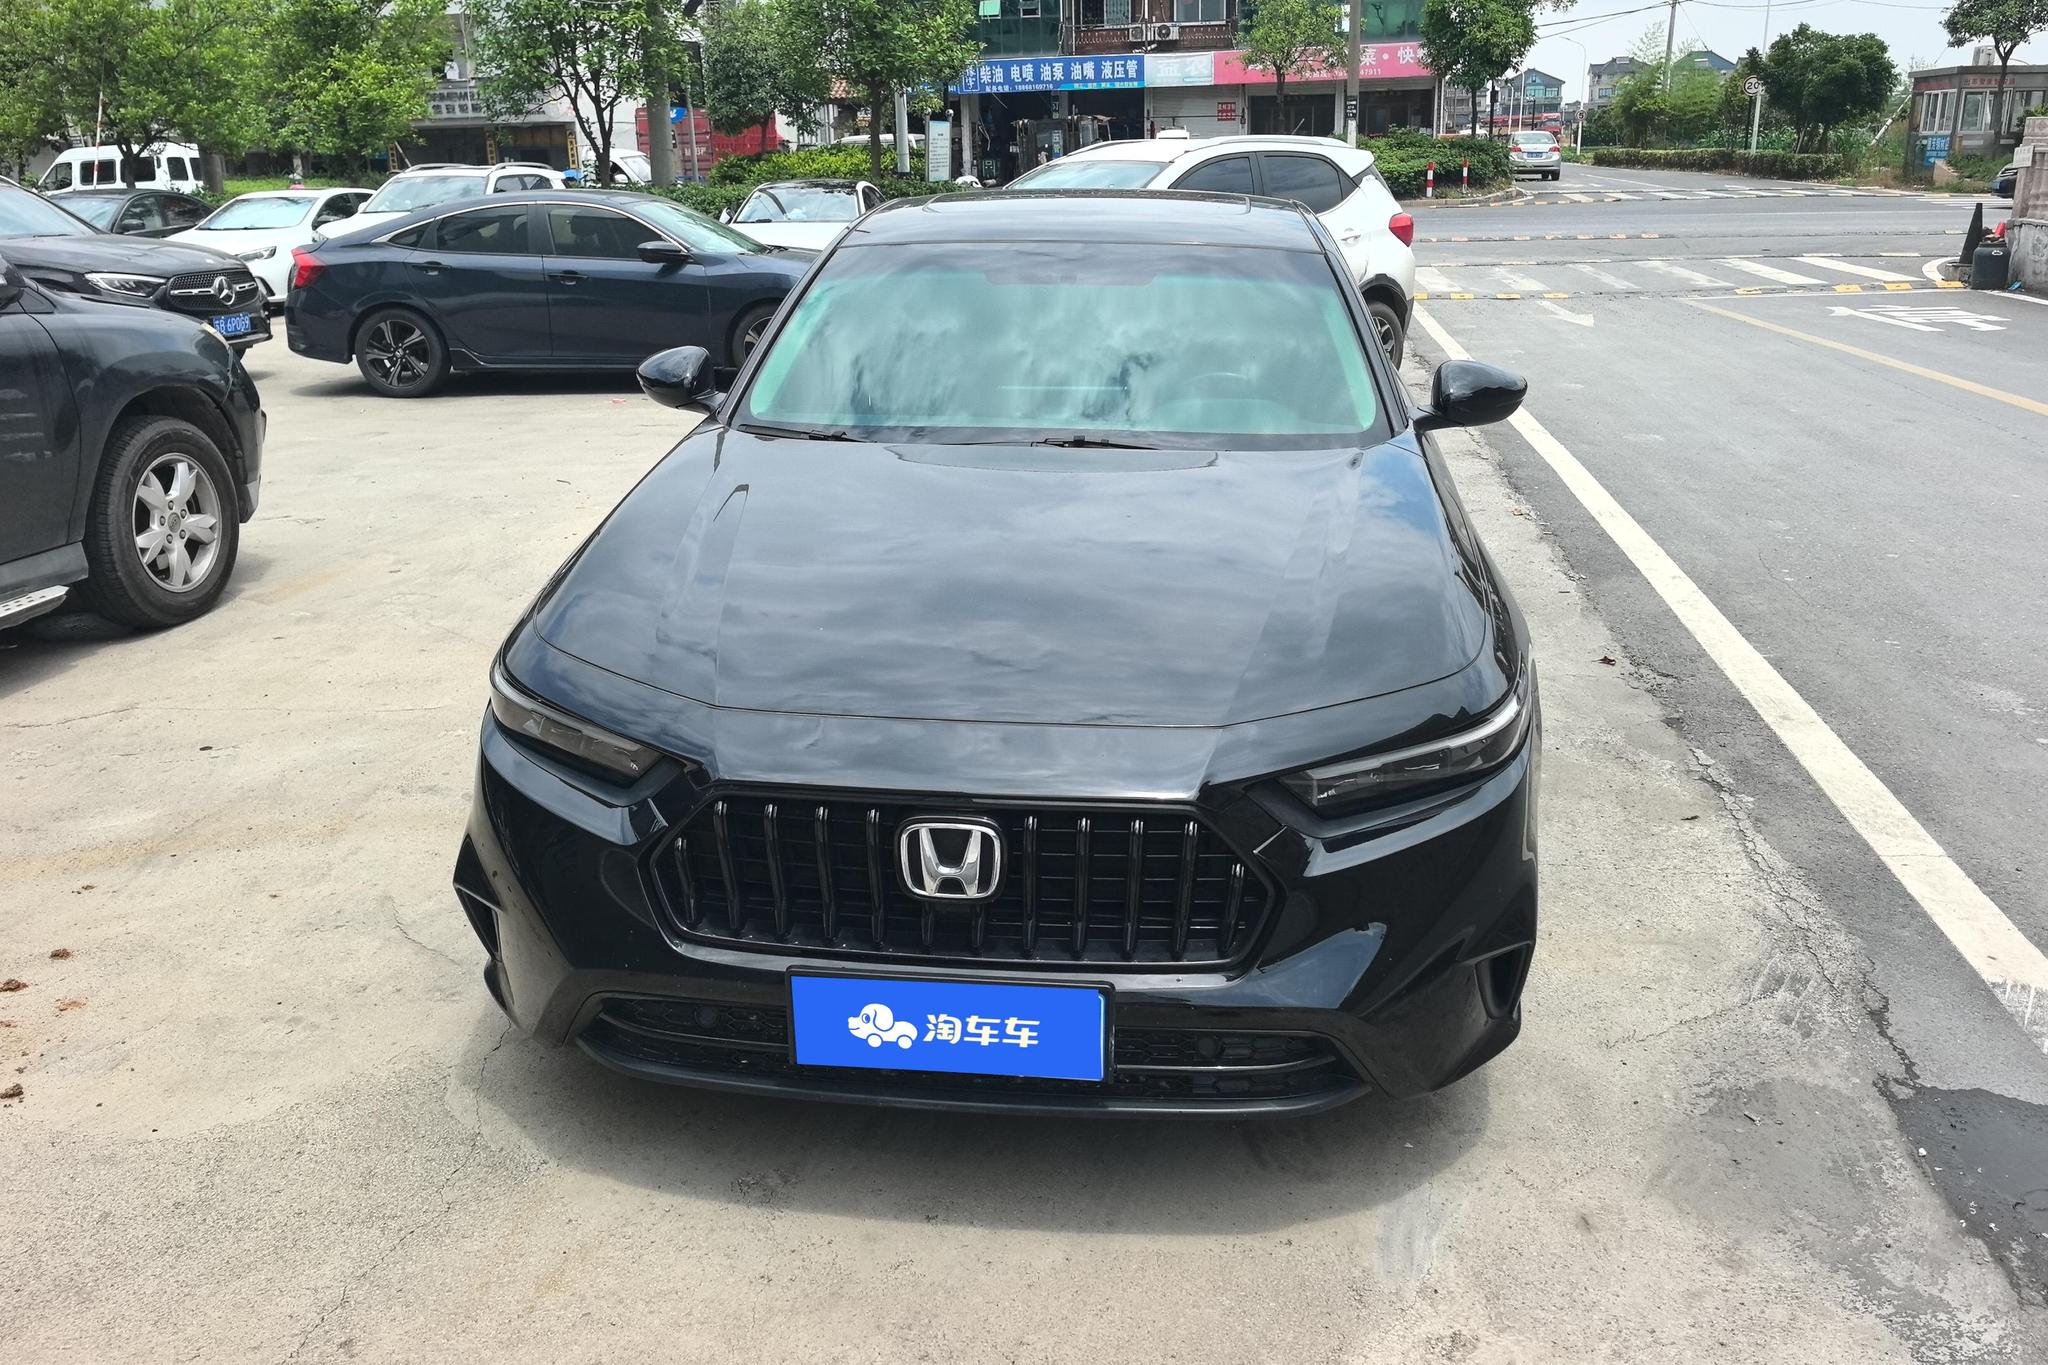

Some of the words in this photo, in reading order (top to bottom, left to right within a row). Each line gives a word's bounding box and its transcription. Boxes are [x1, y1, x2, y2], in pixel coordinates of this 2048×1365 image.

[980, 64, 1004, 84] 柴油
[1010, 62, 1034, 82] 电喷
[1040, 62, 1064, 81] 油泵
[1070, 60, 1095, 80] 油嘴
[1101, 59, 1138, 79] 液压管
[1747, 81, 1760, 90] 20
